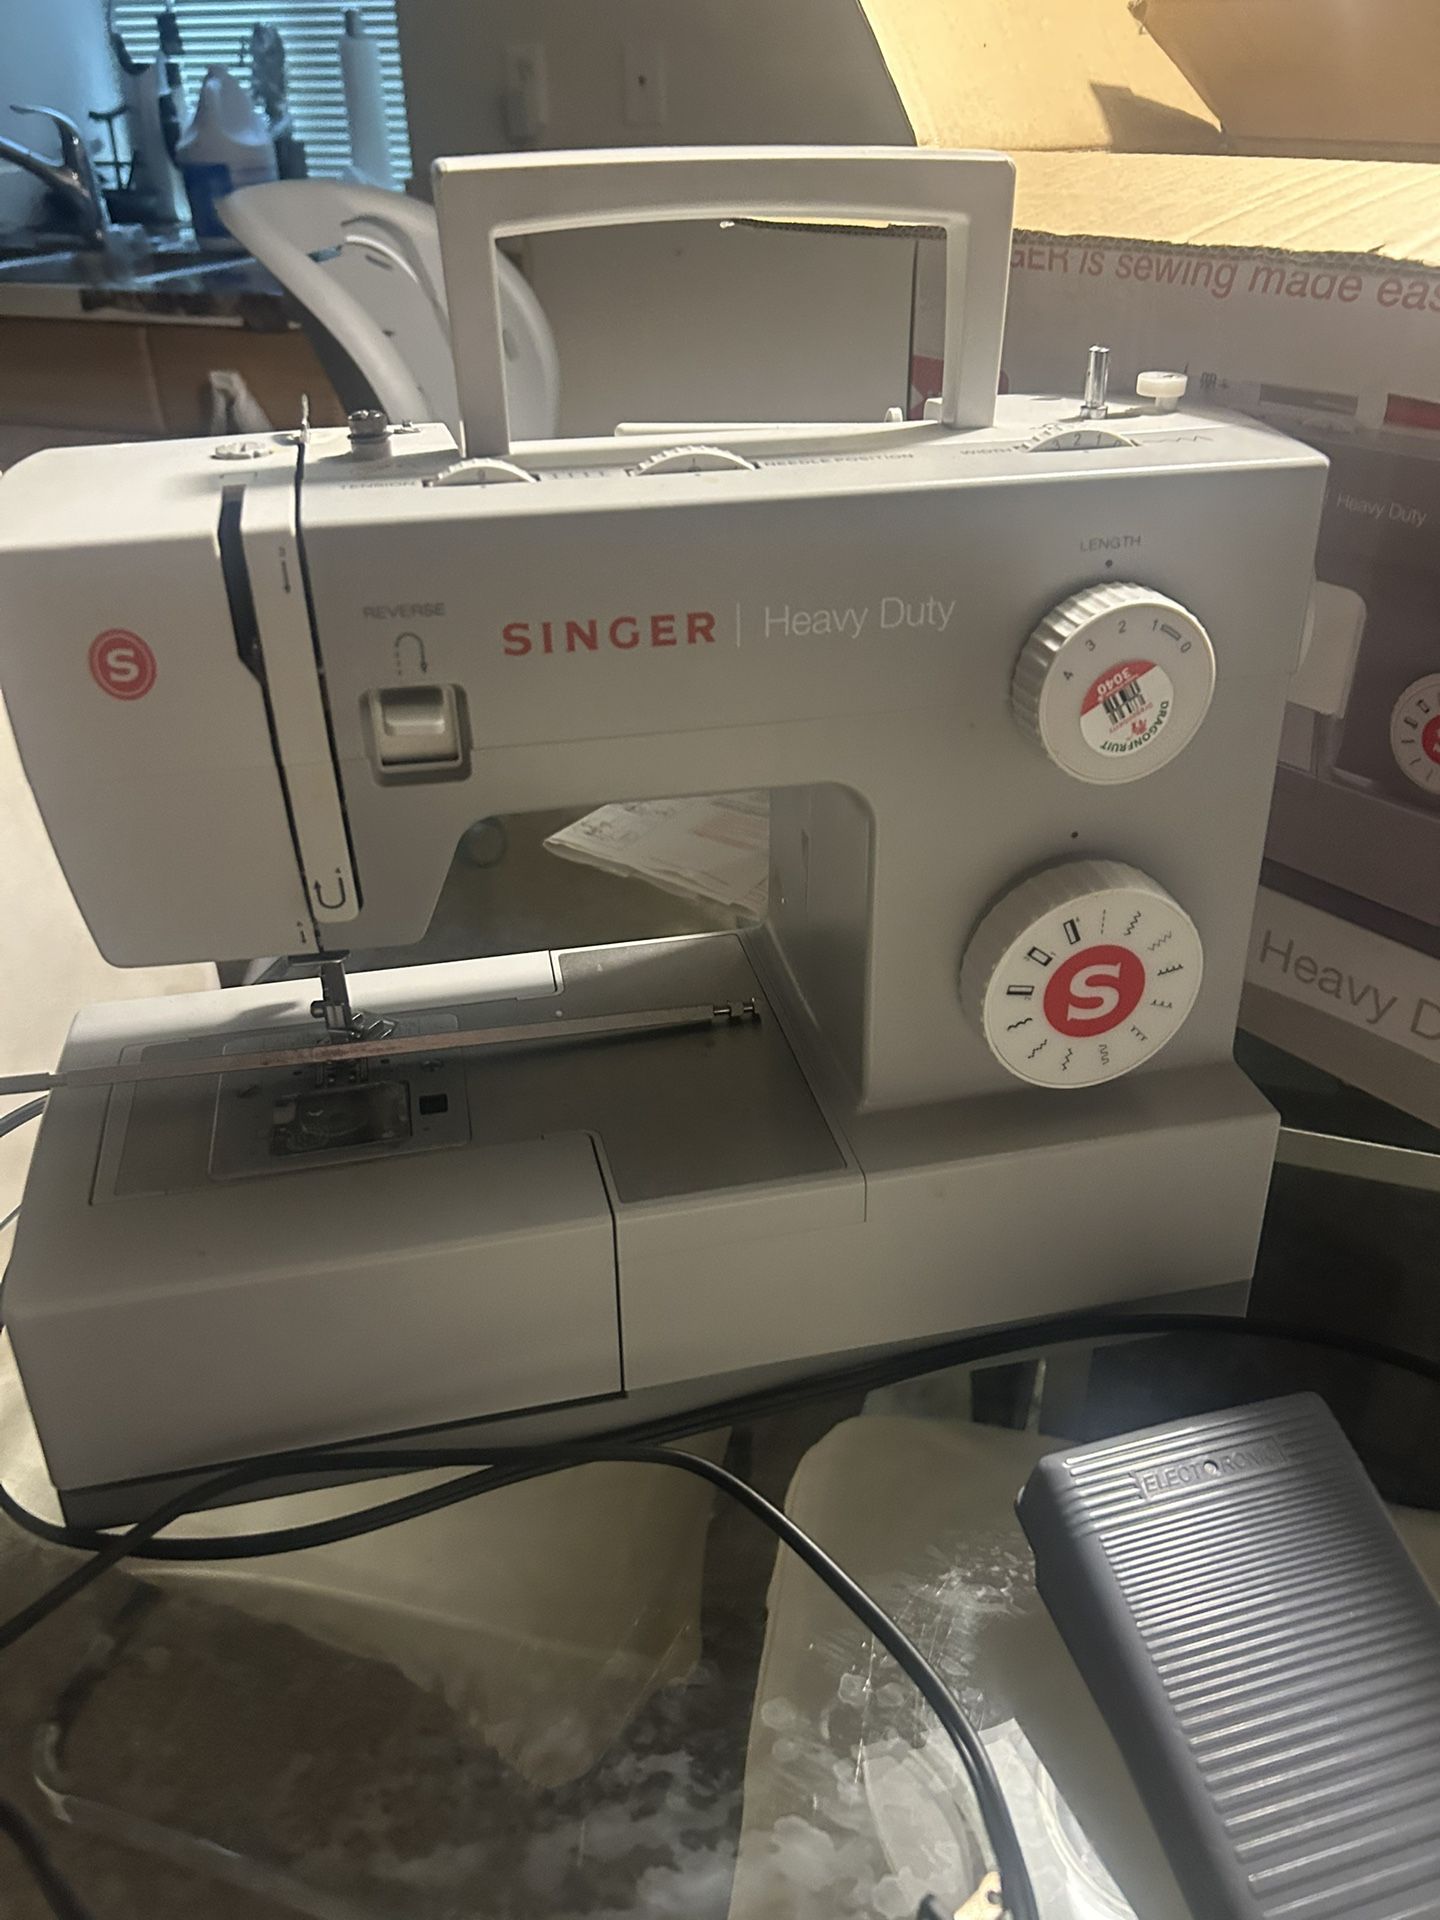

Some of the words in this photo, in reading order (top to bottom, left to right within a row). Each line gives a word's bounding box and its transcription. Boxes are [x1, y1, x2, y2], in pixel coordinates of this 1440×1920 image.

[1079, 250, 1105, 276] is
[1115, 253, 1238, 298] sewing
[1248, 264, 1363, 303] made
[1080, 535, 1142, 551] LENGTH
[362, 602, 446, 619] REVERSE
[502, 611, 717, 656] SINGER
[765, 604, 869, 639] Heavy
[880, 596, 956, 632] Duty
[106, 647, 139, 682] S
[1063, 671, 1073, 680] 4
[1084, 639, 1096, 651] 3
[1117, 620, 1127, 634] 2
[1151, 619, 1159, 632] 1
[1096, 667, 1133, 696] 3040
[1099, 700, 1169, 753] DRAGONFRUIT
[1066, 961, 1122, 1022] S
[1259, 929, 1399, 1025] Heavy
